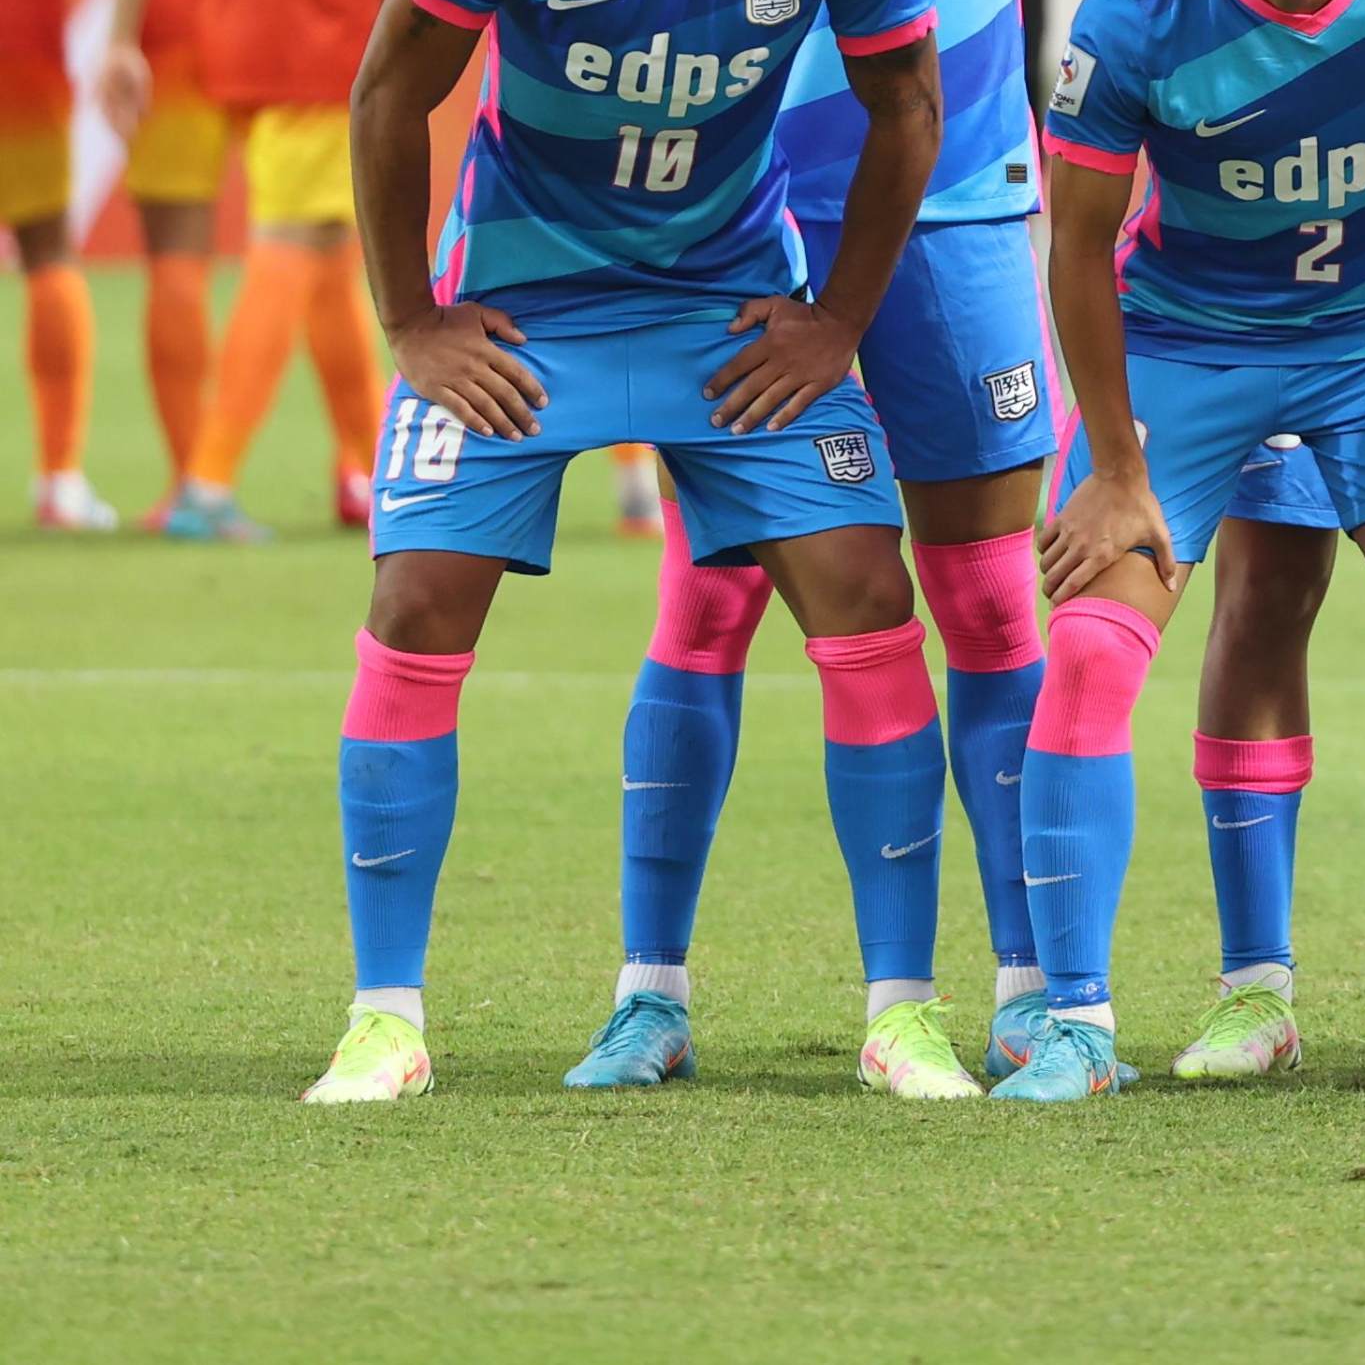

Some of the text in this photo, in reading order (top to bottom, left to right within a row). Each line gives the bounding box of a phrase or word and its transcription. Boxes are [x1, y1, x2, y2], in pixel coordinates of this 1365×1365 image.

[565, 32, 770, 117] edps
[613, 125, 698, 192] 10
[1295, 218, 1343, 283] 2
[384, 398, 465, 483] 10
